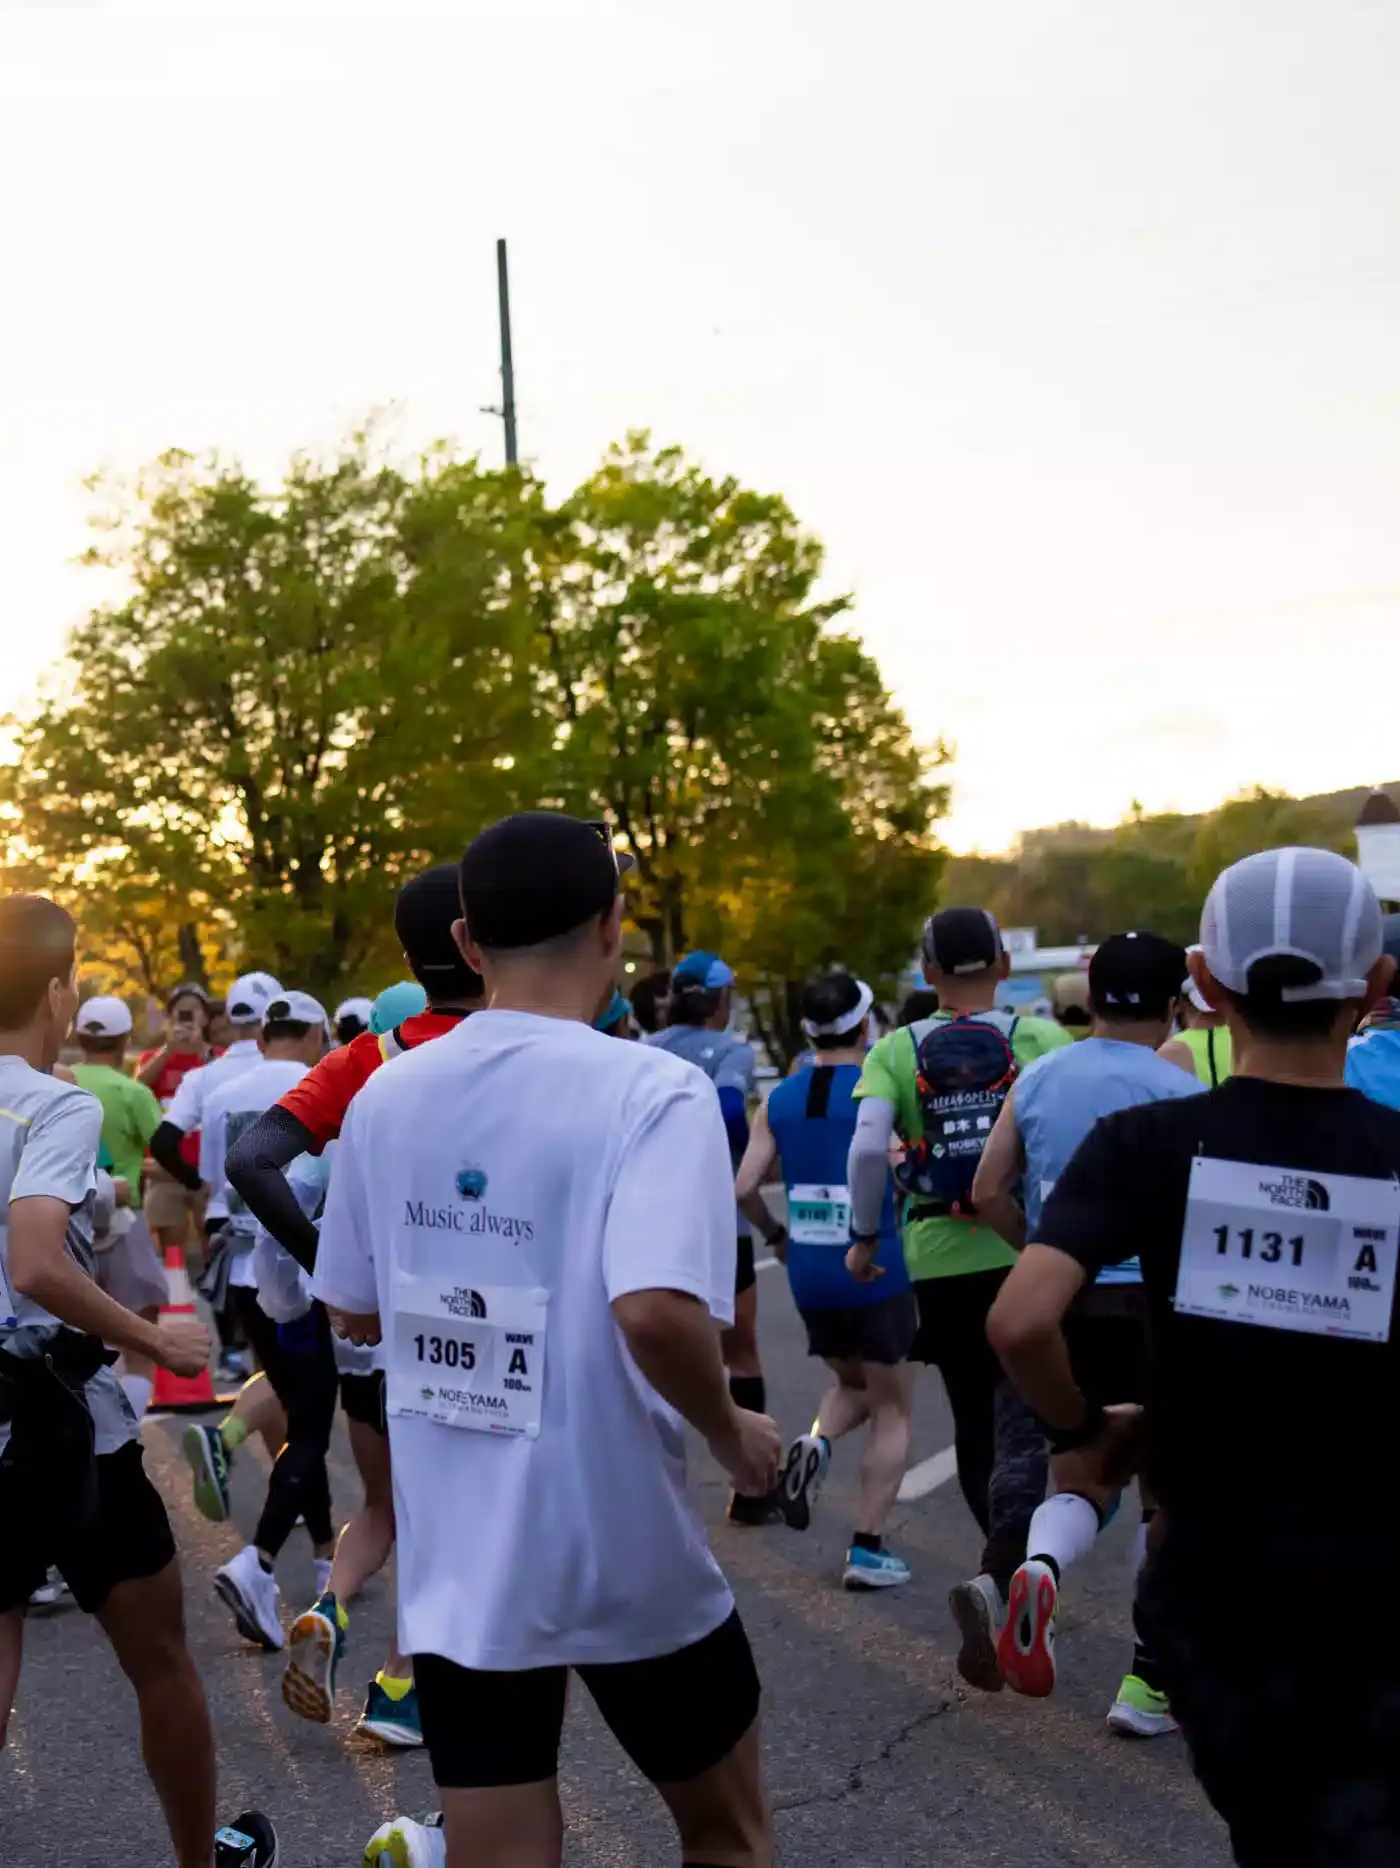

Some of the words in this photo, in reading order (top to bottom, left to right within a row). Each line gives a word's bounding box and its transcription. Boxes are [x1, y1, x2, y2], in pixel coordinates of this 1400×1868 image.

[1280, 1175, 1305, 1188] THE
[1259, 1182, 1305, 1198] NORTH
[1270, 1193, 1304, 1208] FACE
[403, 1200, 465, 1232] Music
[469, 1205, 535, 1246] always
[1212, 1224, 1305, 1267] 1131
[1354, 1244, 1377, 1273] A
[453, 1286, 471, 1298] THE
[1247, 1284, 1352, 1312] NOBEYAMA
[440, 1294, 471, 1307] NORTH
[448, 1304, 471, 1317] FACE
[505, 1332, 534, 1346] WAVE
[414, 1334, 476, 1371] 1305
[508, 1348, 528, 1376] A
